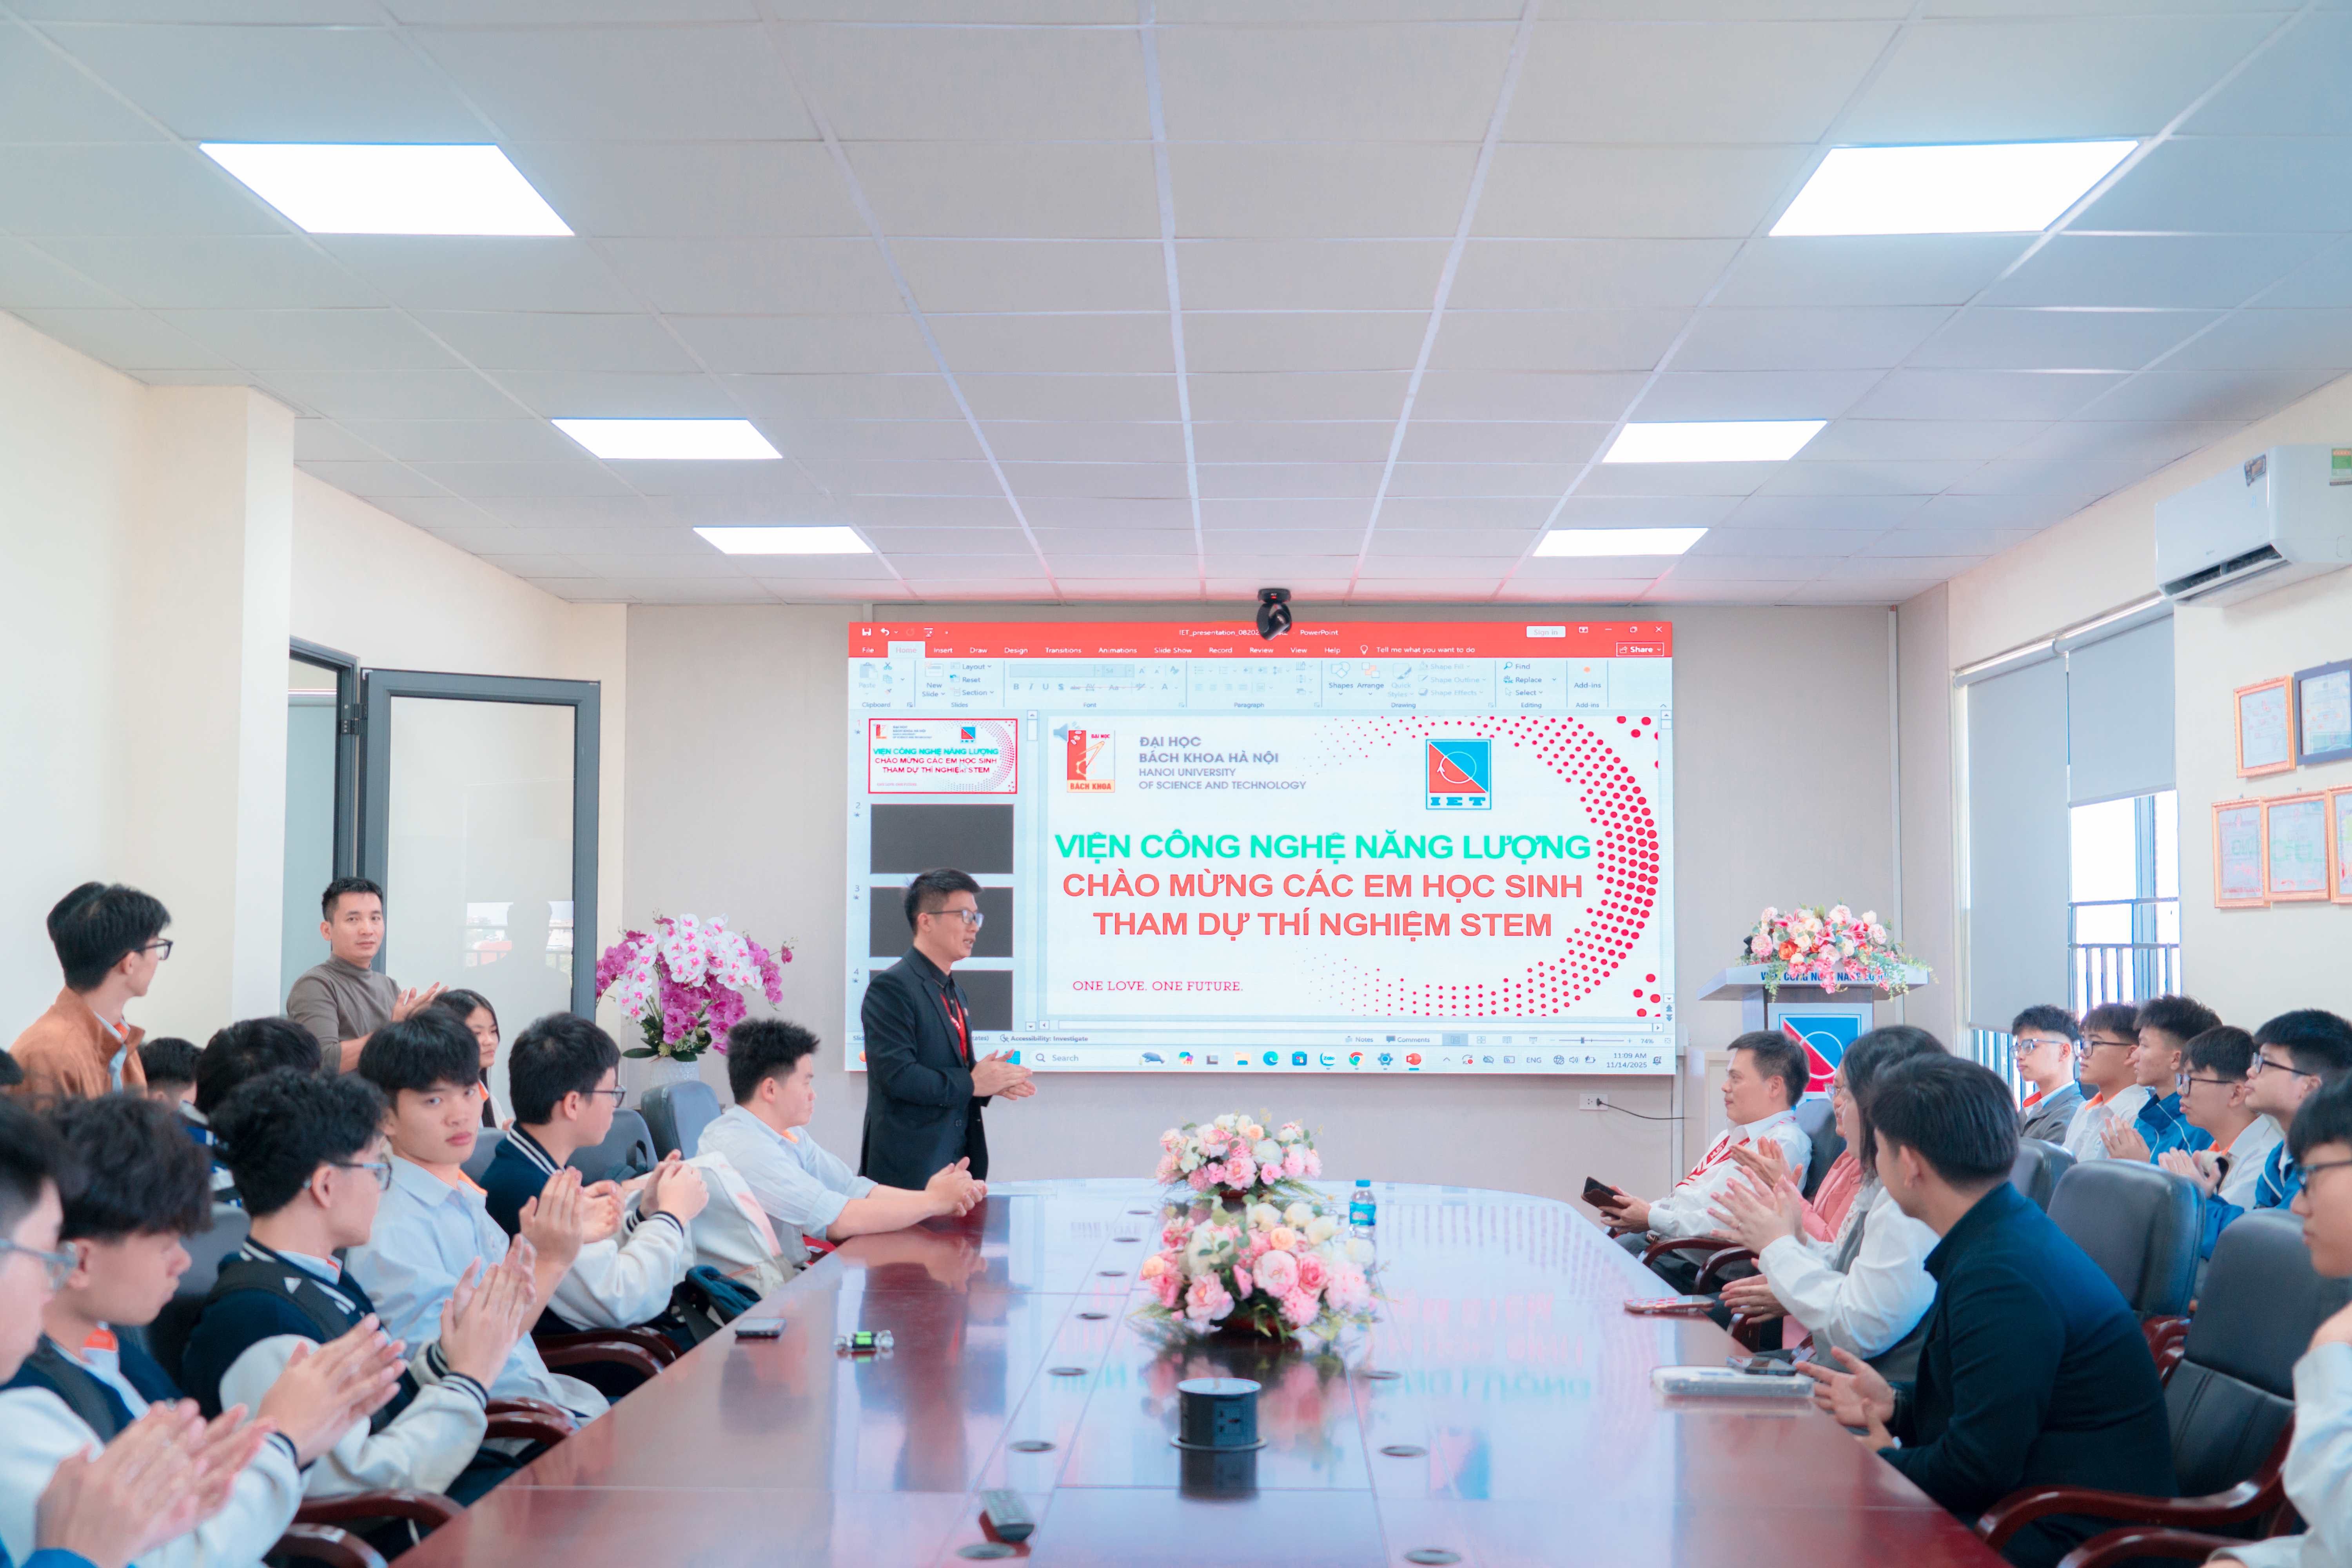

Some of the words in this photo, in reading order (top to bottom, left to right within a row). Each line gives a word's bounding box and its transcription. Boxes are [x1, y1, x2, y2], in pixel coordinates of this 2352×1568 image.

[1140, 737, 1164, 748] ĐẠI
[1169, 737, 1201, 748] HỌC
[873, 748, 891, 756] VIỆN
[918, 748, 942, 756] NGHỆ
[1140, 750, 1179, 762] BÁCH
[1184, 753, 1224, 762] KHOA
[1229, 750, 1249, 762] HÀ
[1253, 751, 1278, 764] NỘI
[1071, 780, 1089, 789] BÁCH
[1430, 797, 1486, 806] IET
[1054, 832, 1130, 864] VIỆN
[1141, 829, 1240, 858] CÔNG
[1250, 832, 1346, 865] NGHỆ
[1356, 829, 1453, 859] NĂNG
[1464, 835, 1590, 865] LƯỢNG
[1063, 869, 1159, 897] CHÀO
[1170, 869, 1272, 897] MỪNG
[1283, 869, 1353, 897] CÁC
[1365, 875, 1411, 897] EM
[1423, 875, 1494, 903] HỌC
[1506, 875, 1581, 898] SINH
[1093, 913, 1187, 935] THAM
[1199, 913, 1250, 941] DỰ
[1258, 907, 1310, 935] THÍ
[1321, 911, 1450, 942] NGHIỆM
[1461, 913, 1551, 936] STEM
[1073, 981, 1103, 990] ONE
[1108, 981, 1147, 990] LOVE.
[1152, 981, 1182, 991] ONE
[1187, 982, 1243, 991] FUTURE.
[1710, 1142, 1725, 1159] HUST
